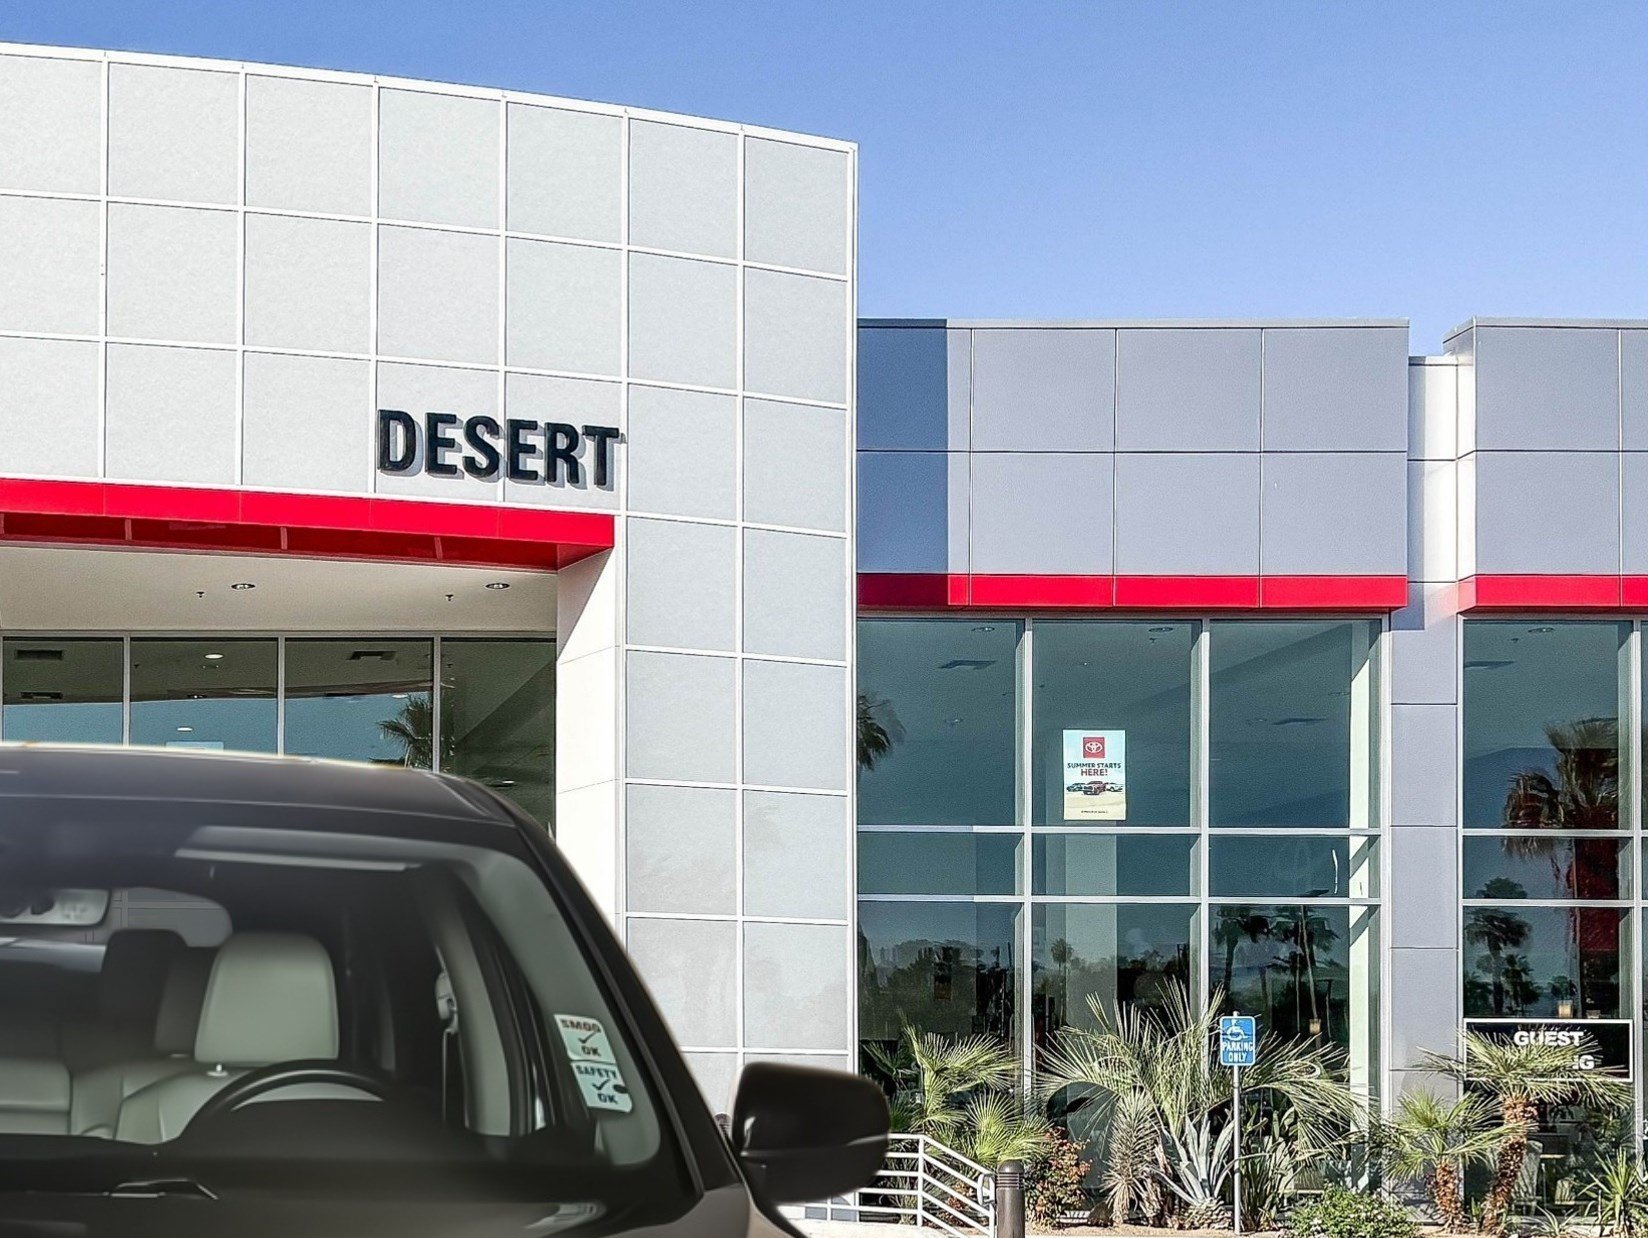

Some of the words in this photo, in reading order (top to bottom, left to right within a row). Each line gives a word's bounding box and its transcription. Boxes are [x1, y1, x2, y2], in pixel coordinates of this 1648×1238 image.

[377, 408, 621, 487] DESERT
[1080, 768, 1108, 777] HERE!
[1513, 1030, 1584, 1047] GUEST
[1222, 1041, 1254, 1052] PARKING
[1228, 1051, 1248, 1062] ONLY
[575, 1064, 618, 1079] SAFETY
